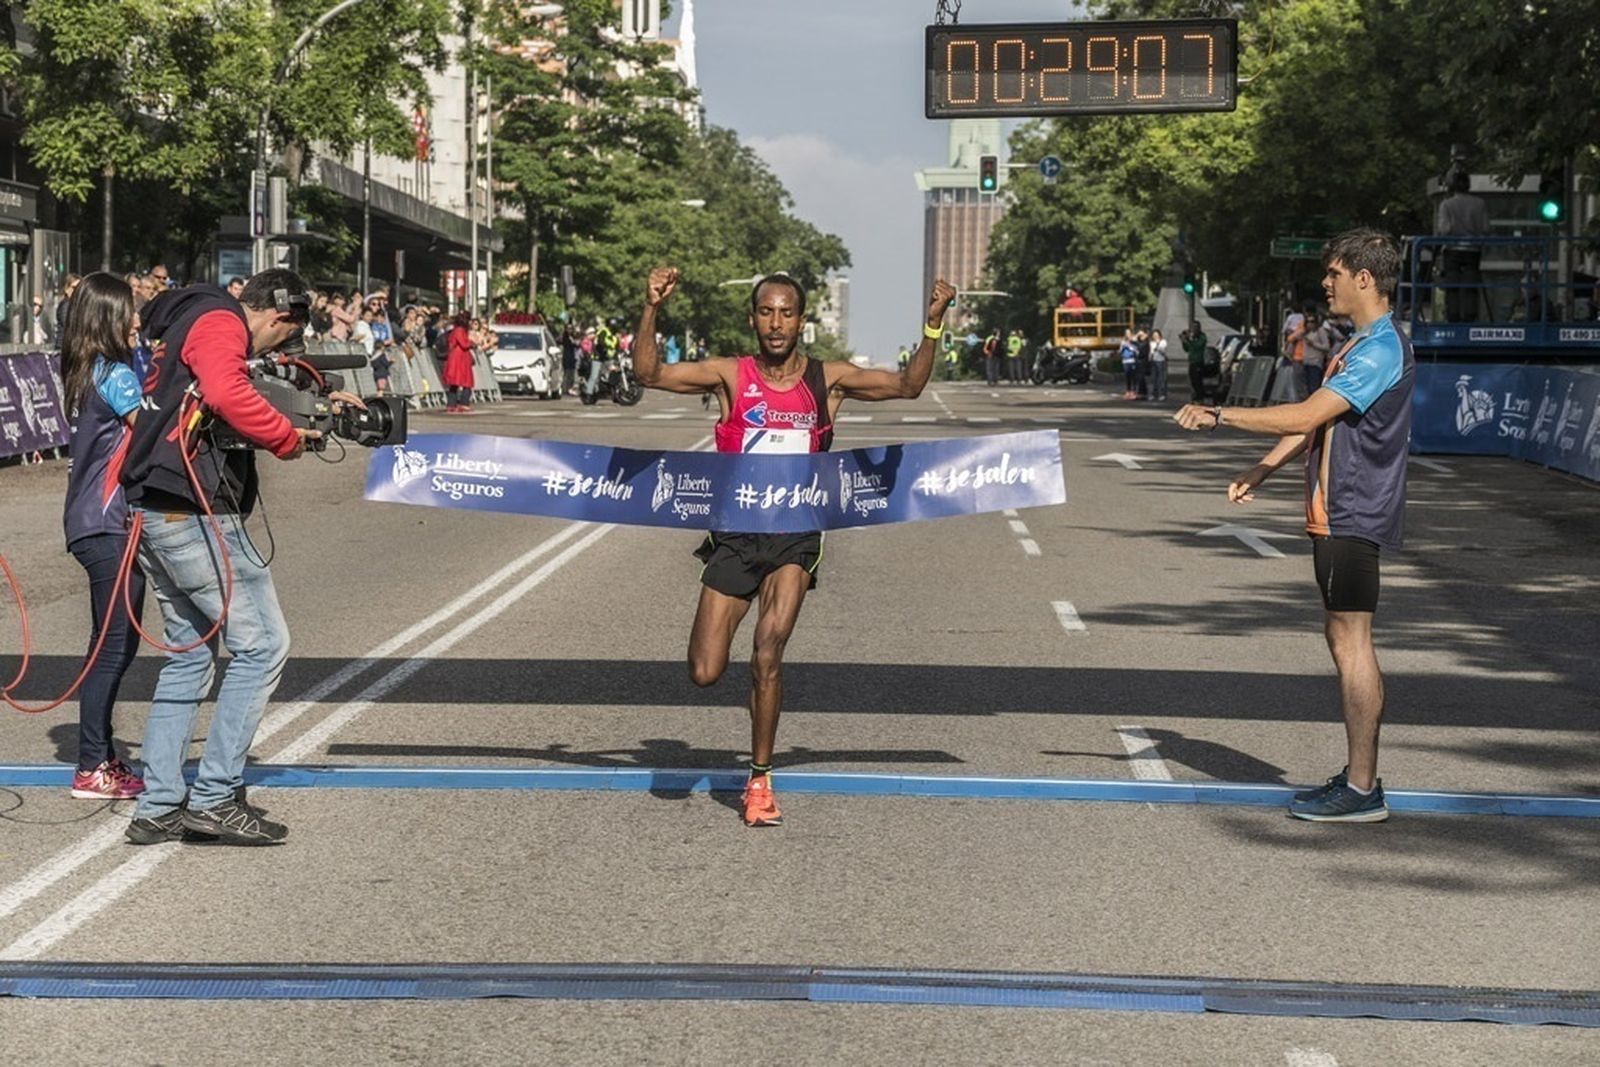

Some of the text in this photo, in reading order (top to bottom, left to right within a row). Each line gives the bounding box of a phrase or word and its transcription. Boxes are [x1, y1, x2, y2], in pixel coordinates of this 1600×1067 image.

[947, 35, 1214, 104] 00:29:07
[434, 452, 503, 479] Liberty
[431, 475, 504, 500] Seguros
[677, 473, 713, 497] Liberty
[853, 471, 882, 491] Liberty
[671, 497, 711, 521] Seguros
[853, 497, 888, 518] Seguros
